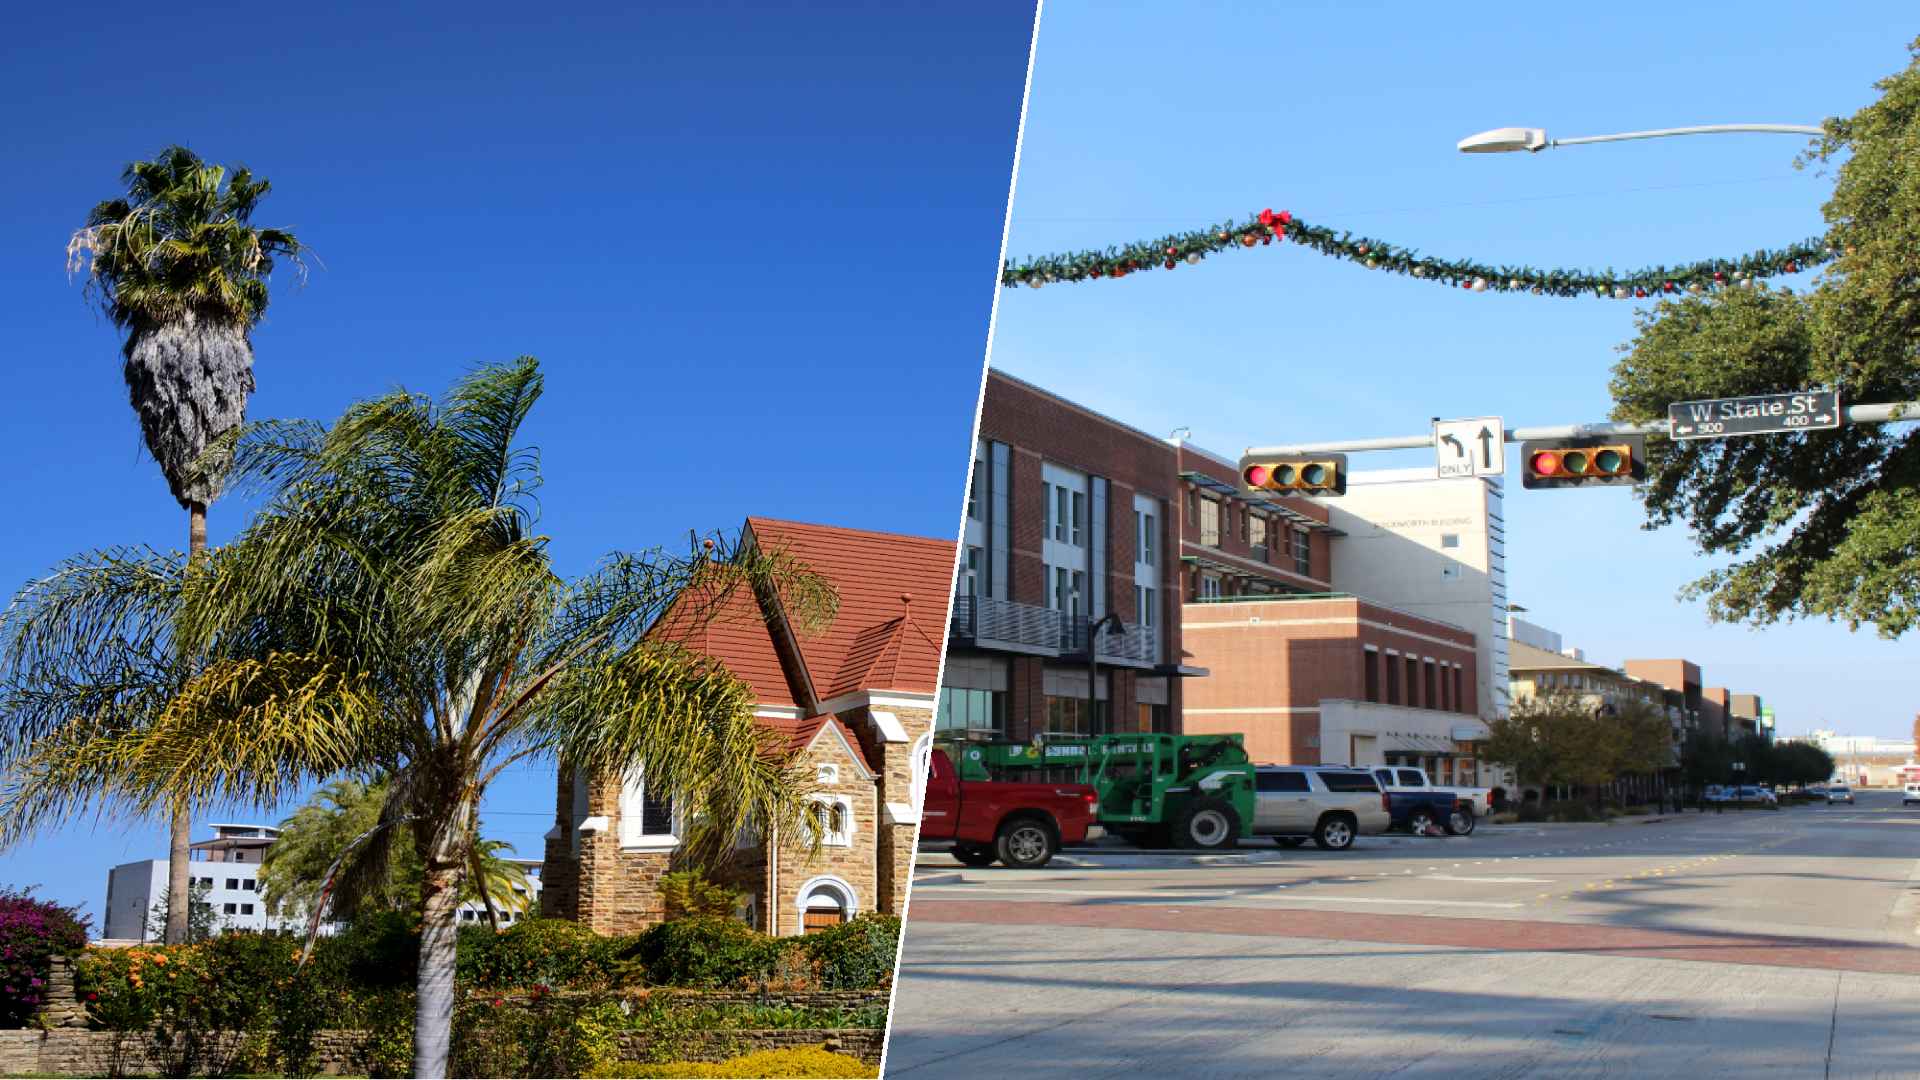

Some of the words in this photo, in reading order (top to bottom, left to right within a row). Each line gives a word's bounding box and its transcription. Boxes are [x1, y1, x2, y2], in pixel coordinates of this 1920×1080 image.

[1690, 405, 1712, 421] W
[1721, 399, 1784, 420] State
[1790, 396, 1817, 413] St
[1783, 415, 1809, 426] 400
[1698, 422, 1724, 434] 500
[1440, 463, 1472, 474] ONLY
